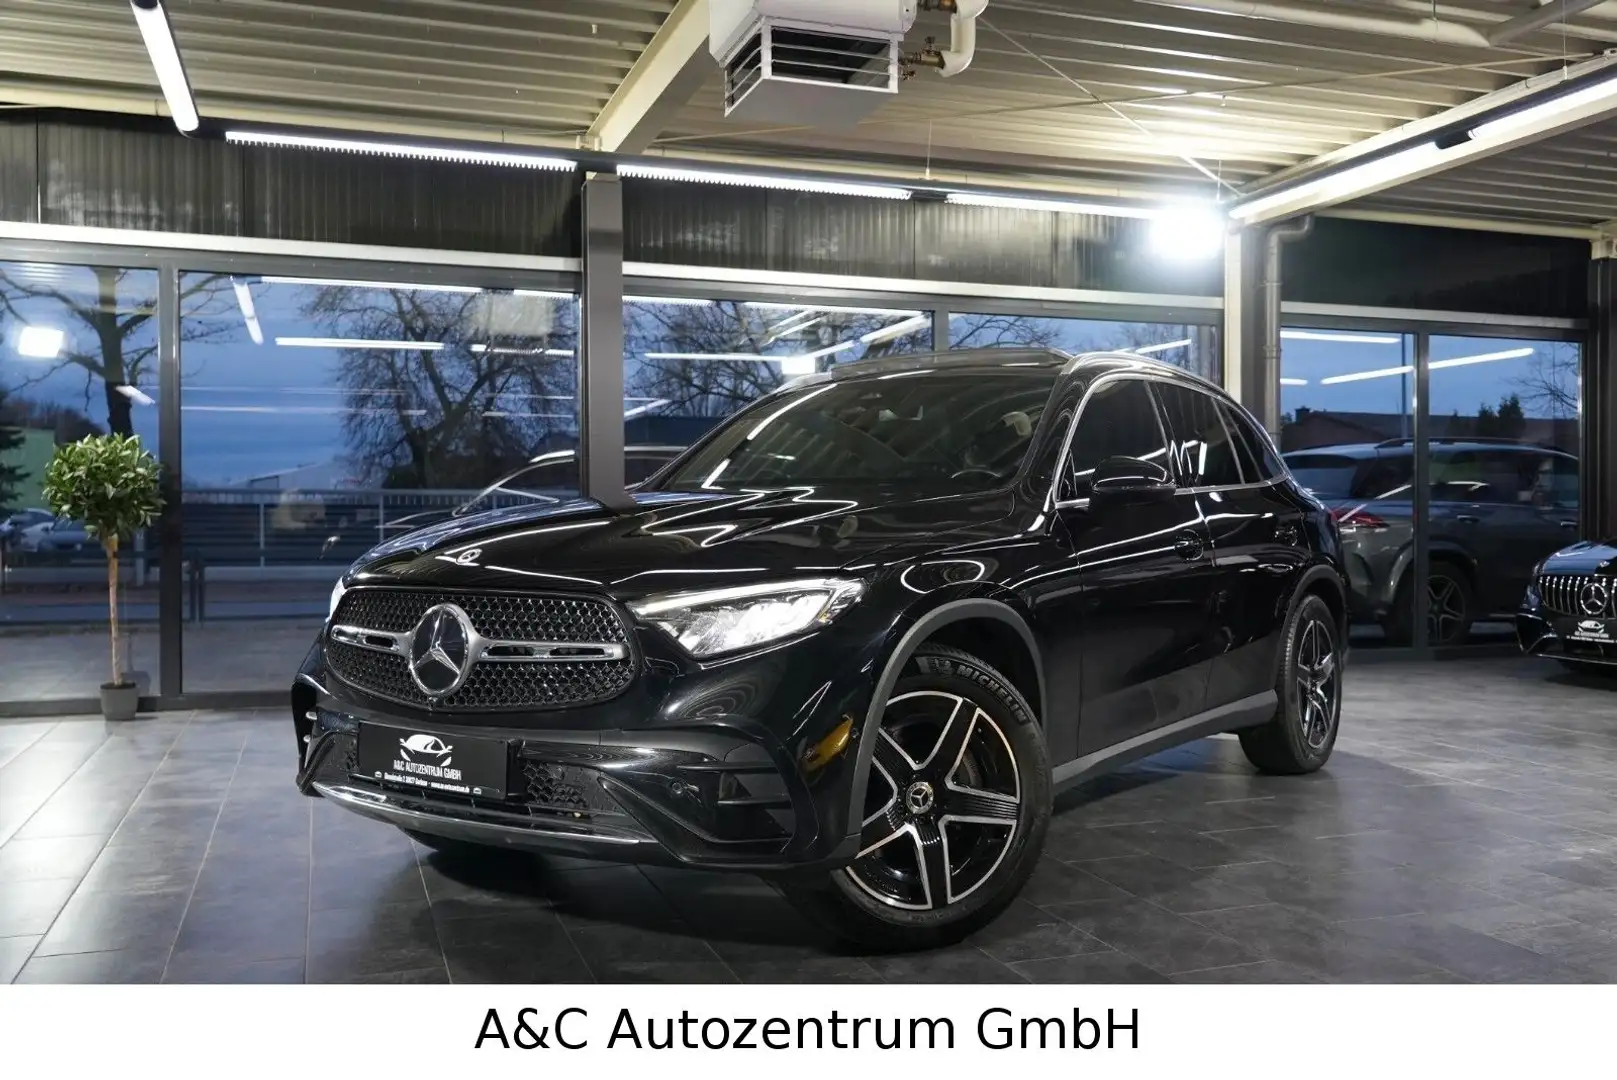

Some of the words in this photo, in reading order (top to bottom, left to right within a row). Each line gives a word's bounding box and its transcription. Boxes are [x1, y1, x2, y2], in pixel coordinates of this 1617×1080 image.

[957, 664, 1028, 724] MICHELIN
[405, 762, 443, 777] AUTOZENTRUM
[443, 768, 462, 780] GMBH
